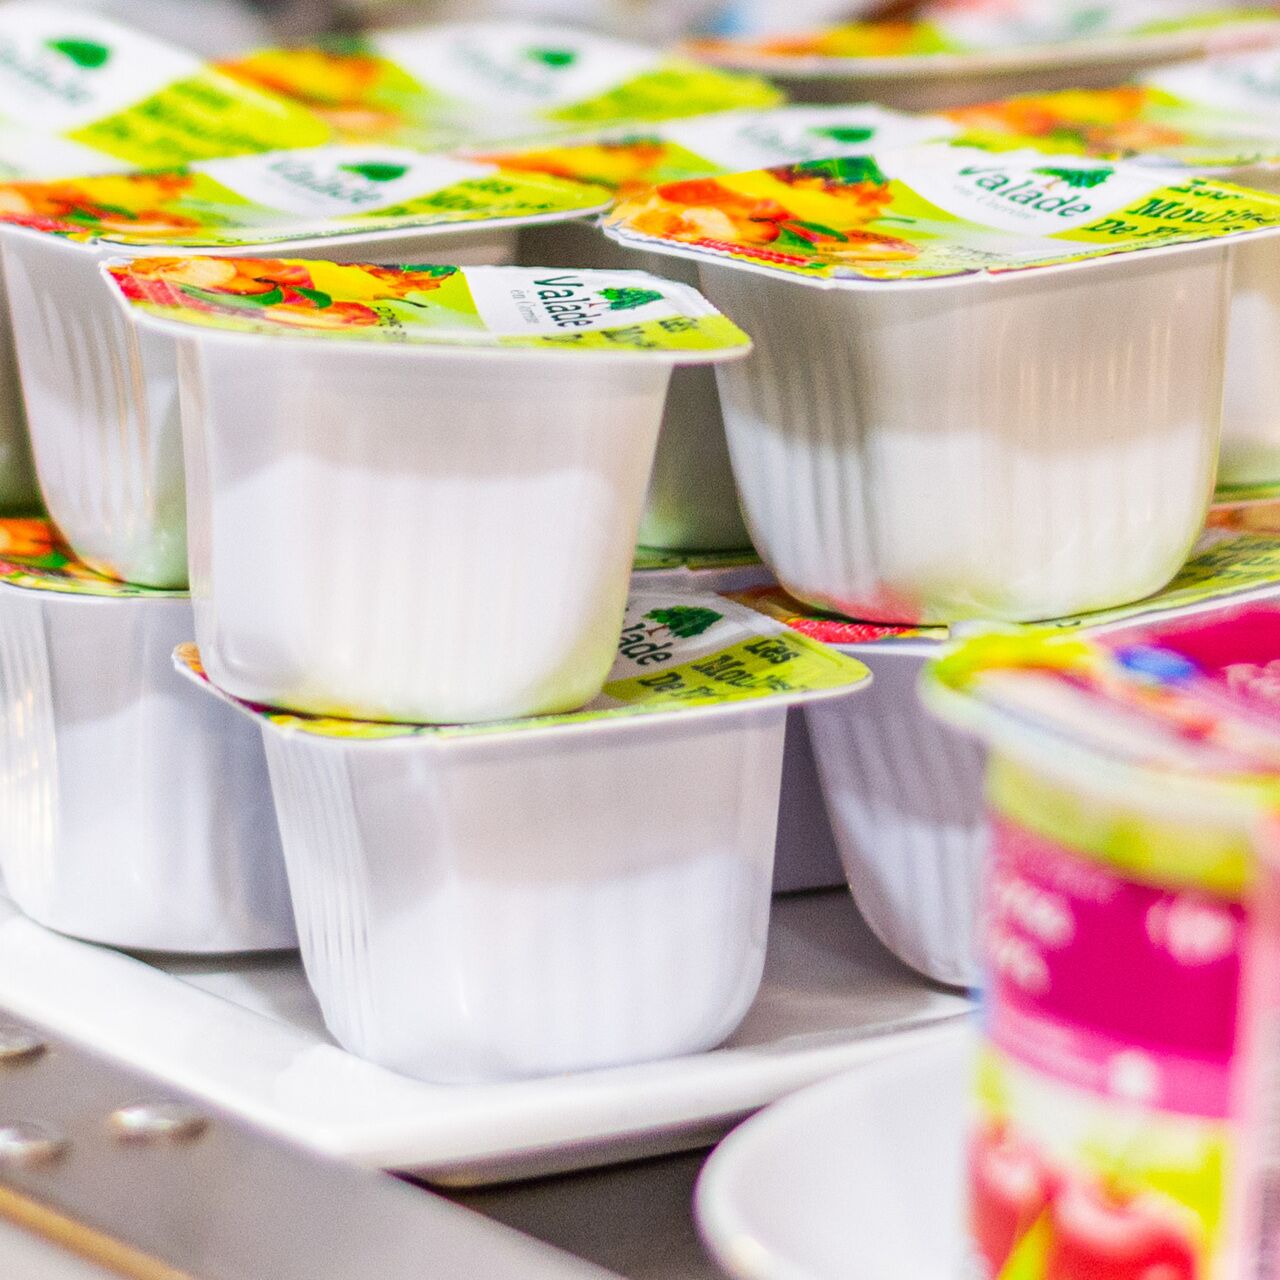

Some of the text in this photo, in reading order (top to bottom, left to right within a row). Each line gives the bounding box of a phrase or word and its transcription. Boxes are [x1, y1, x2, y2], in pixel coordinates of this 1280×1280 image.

[958, 166, 1093, 218] Valade
[533, 274, 602, 328] Valade
[619, 610, 674, 667] lade
[743, 637, 801, 665] Les
[637, 671, 687, 693] De
